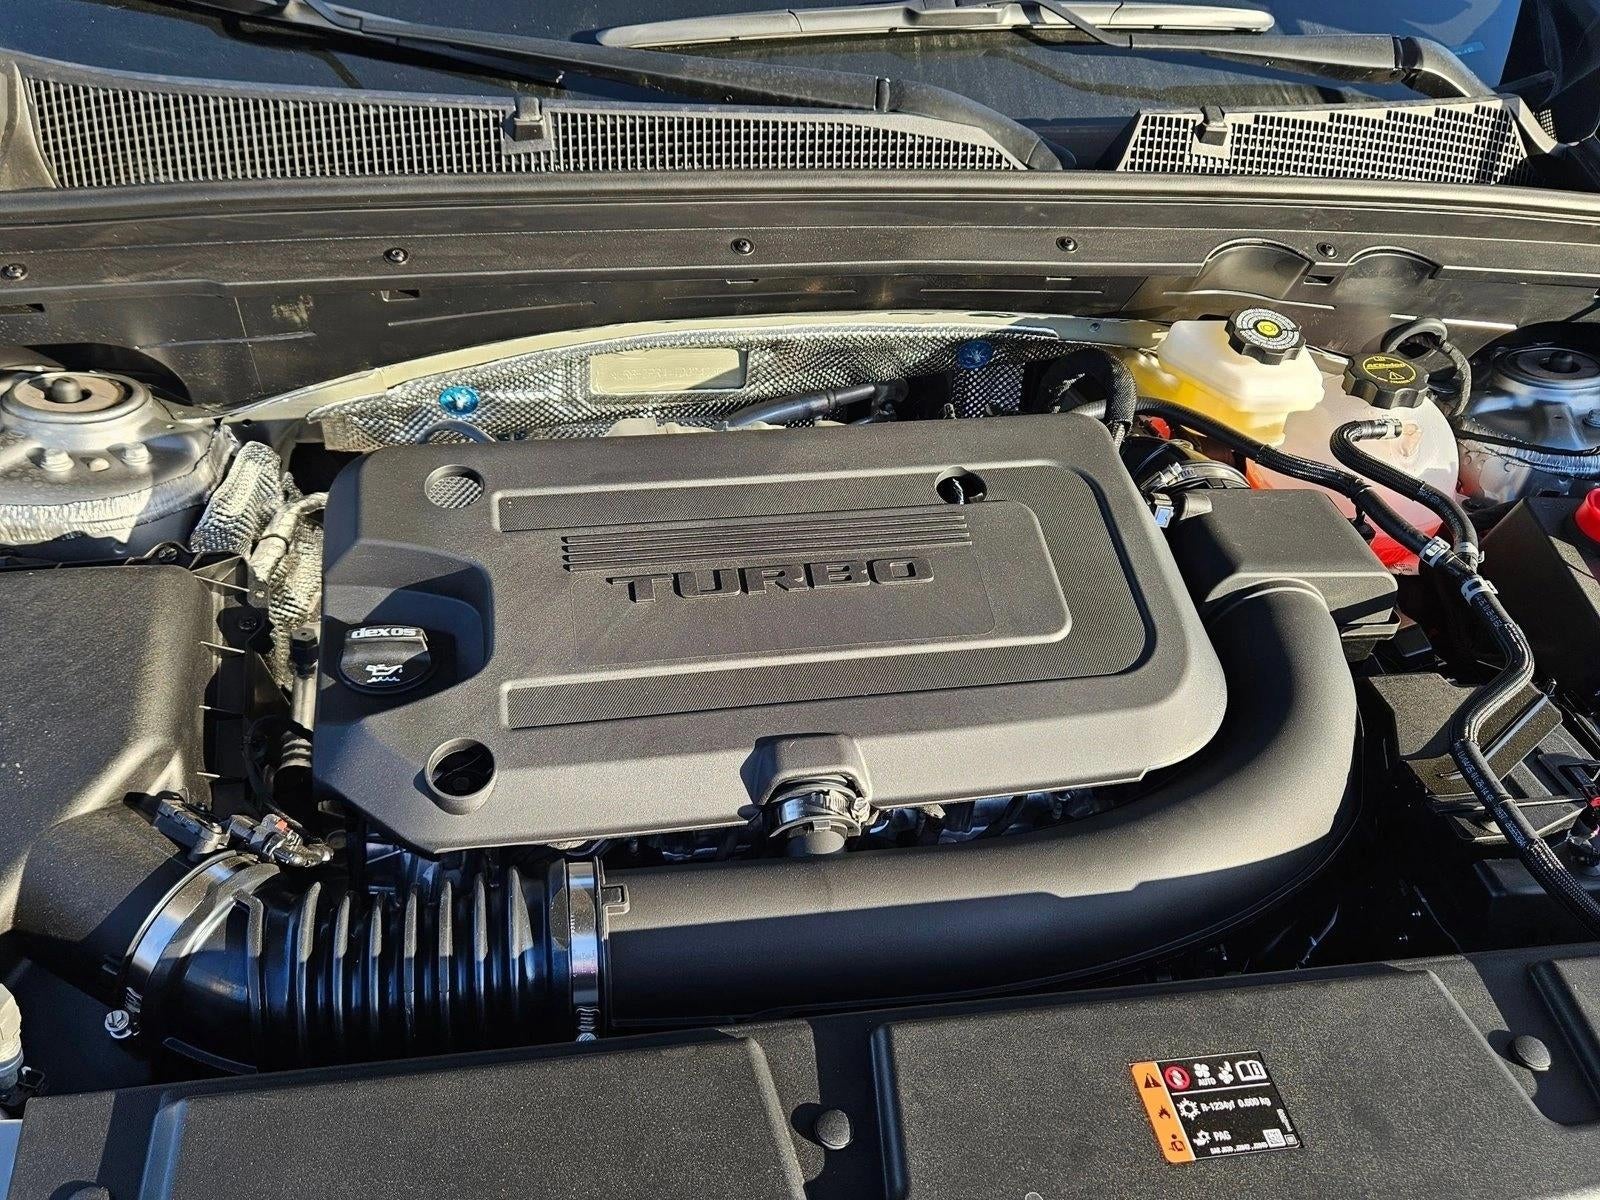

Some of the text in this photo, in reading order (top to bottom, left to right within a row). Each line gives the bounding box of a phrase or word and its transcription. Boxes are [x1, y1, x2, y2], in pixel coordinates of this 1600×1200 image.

[606, 556, 934, 603] TURBO
[351, 627, 417, 638] dexos
[1198, 1078, 1216, 1086] AUTO
[1213, 1131, 1232, 1141] PAG
